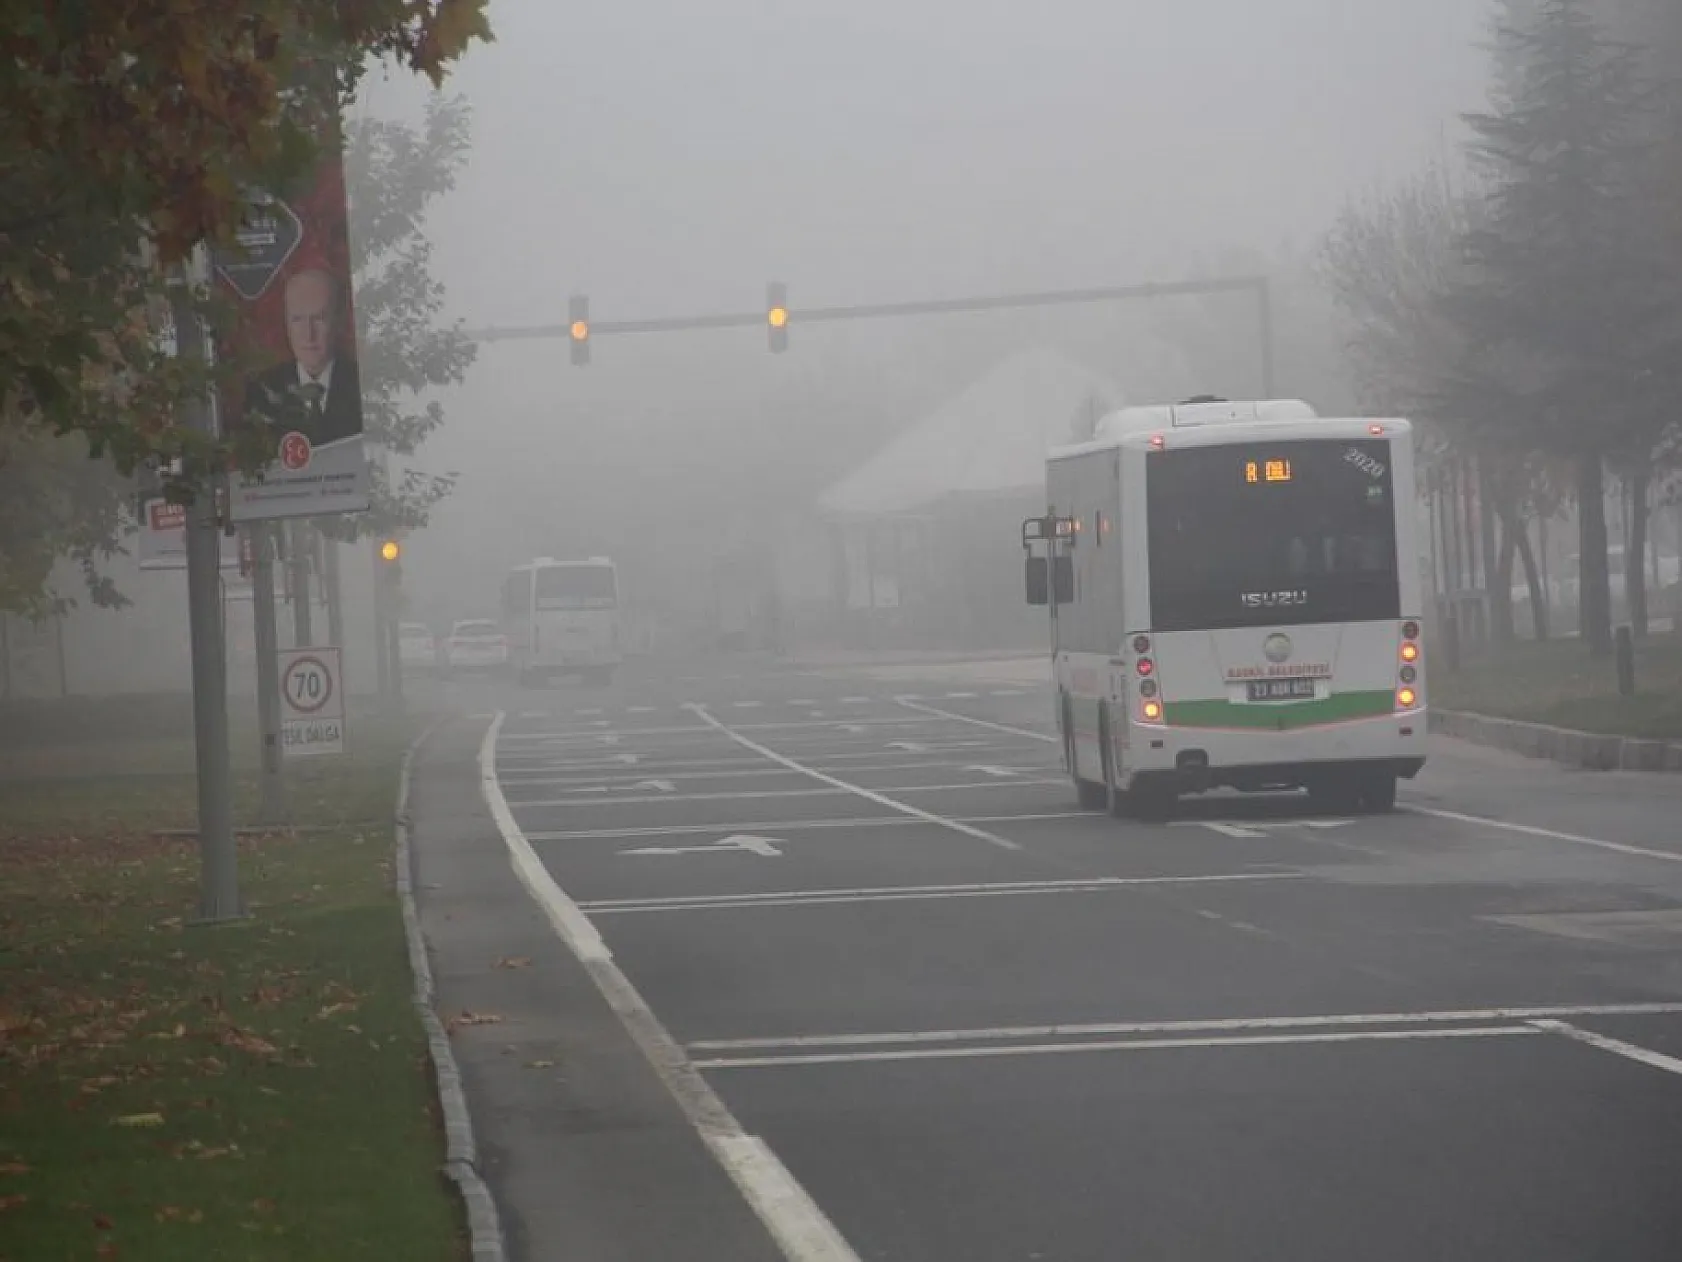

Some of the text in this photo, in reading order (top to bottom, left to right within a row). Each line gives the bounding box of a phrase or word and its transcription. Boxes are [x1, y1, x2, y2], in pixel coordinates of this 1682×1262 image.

[1343, 447, 1385, 477] 2020
[1241, 590, 1307, 607] ISUZU
[293, 671, 320, 699] 70
